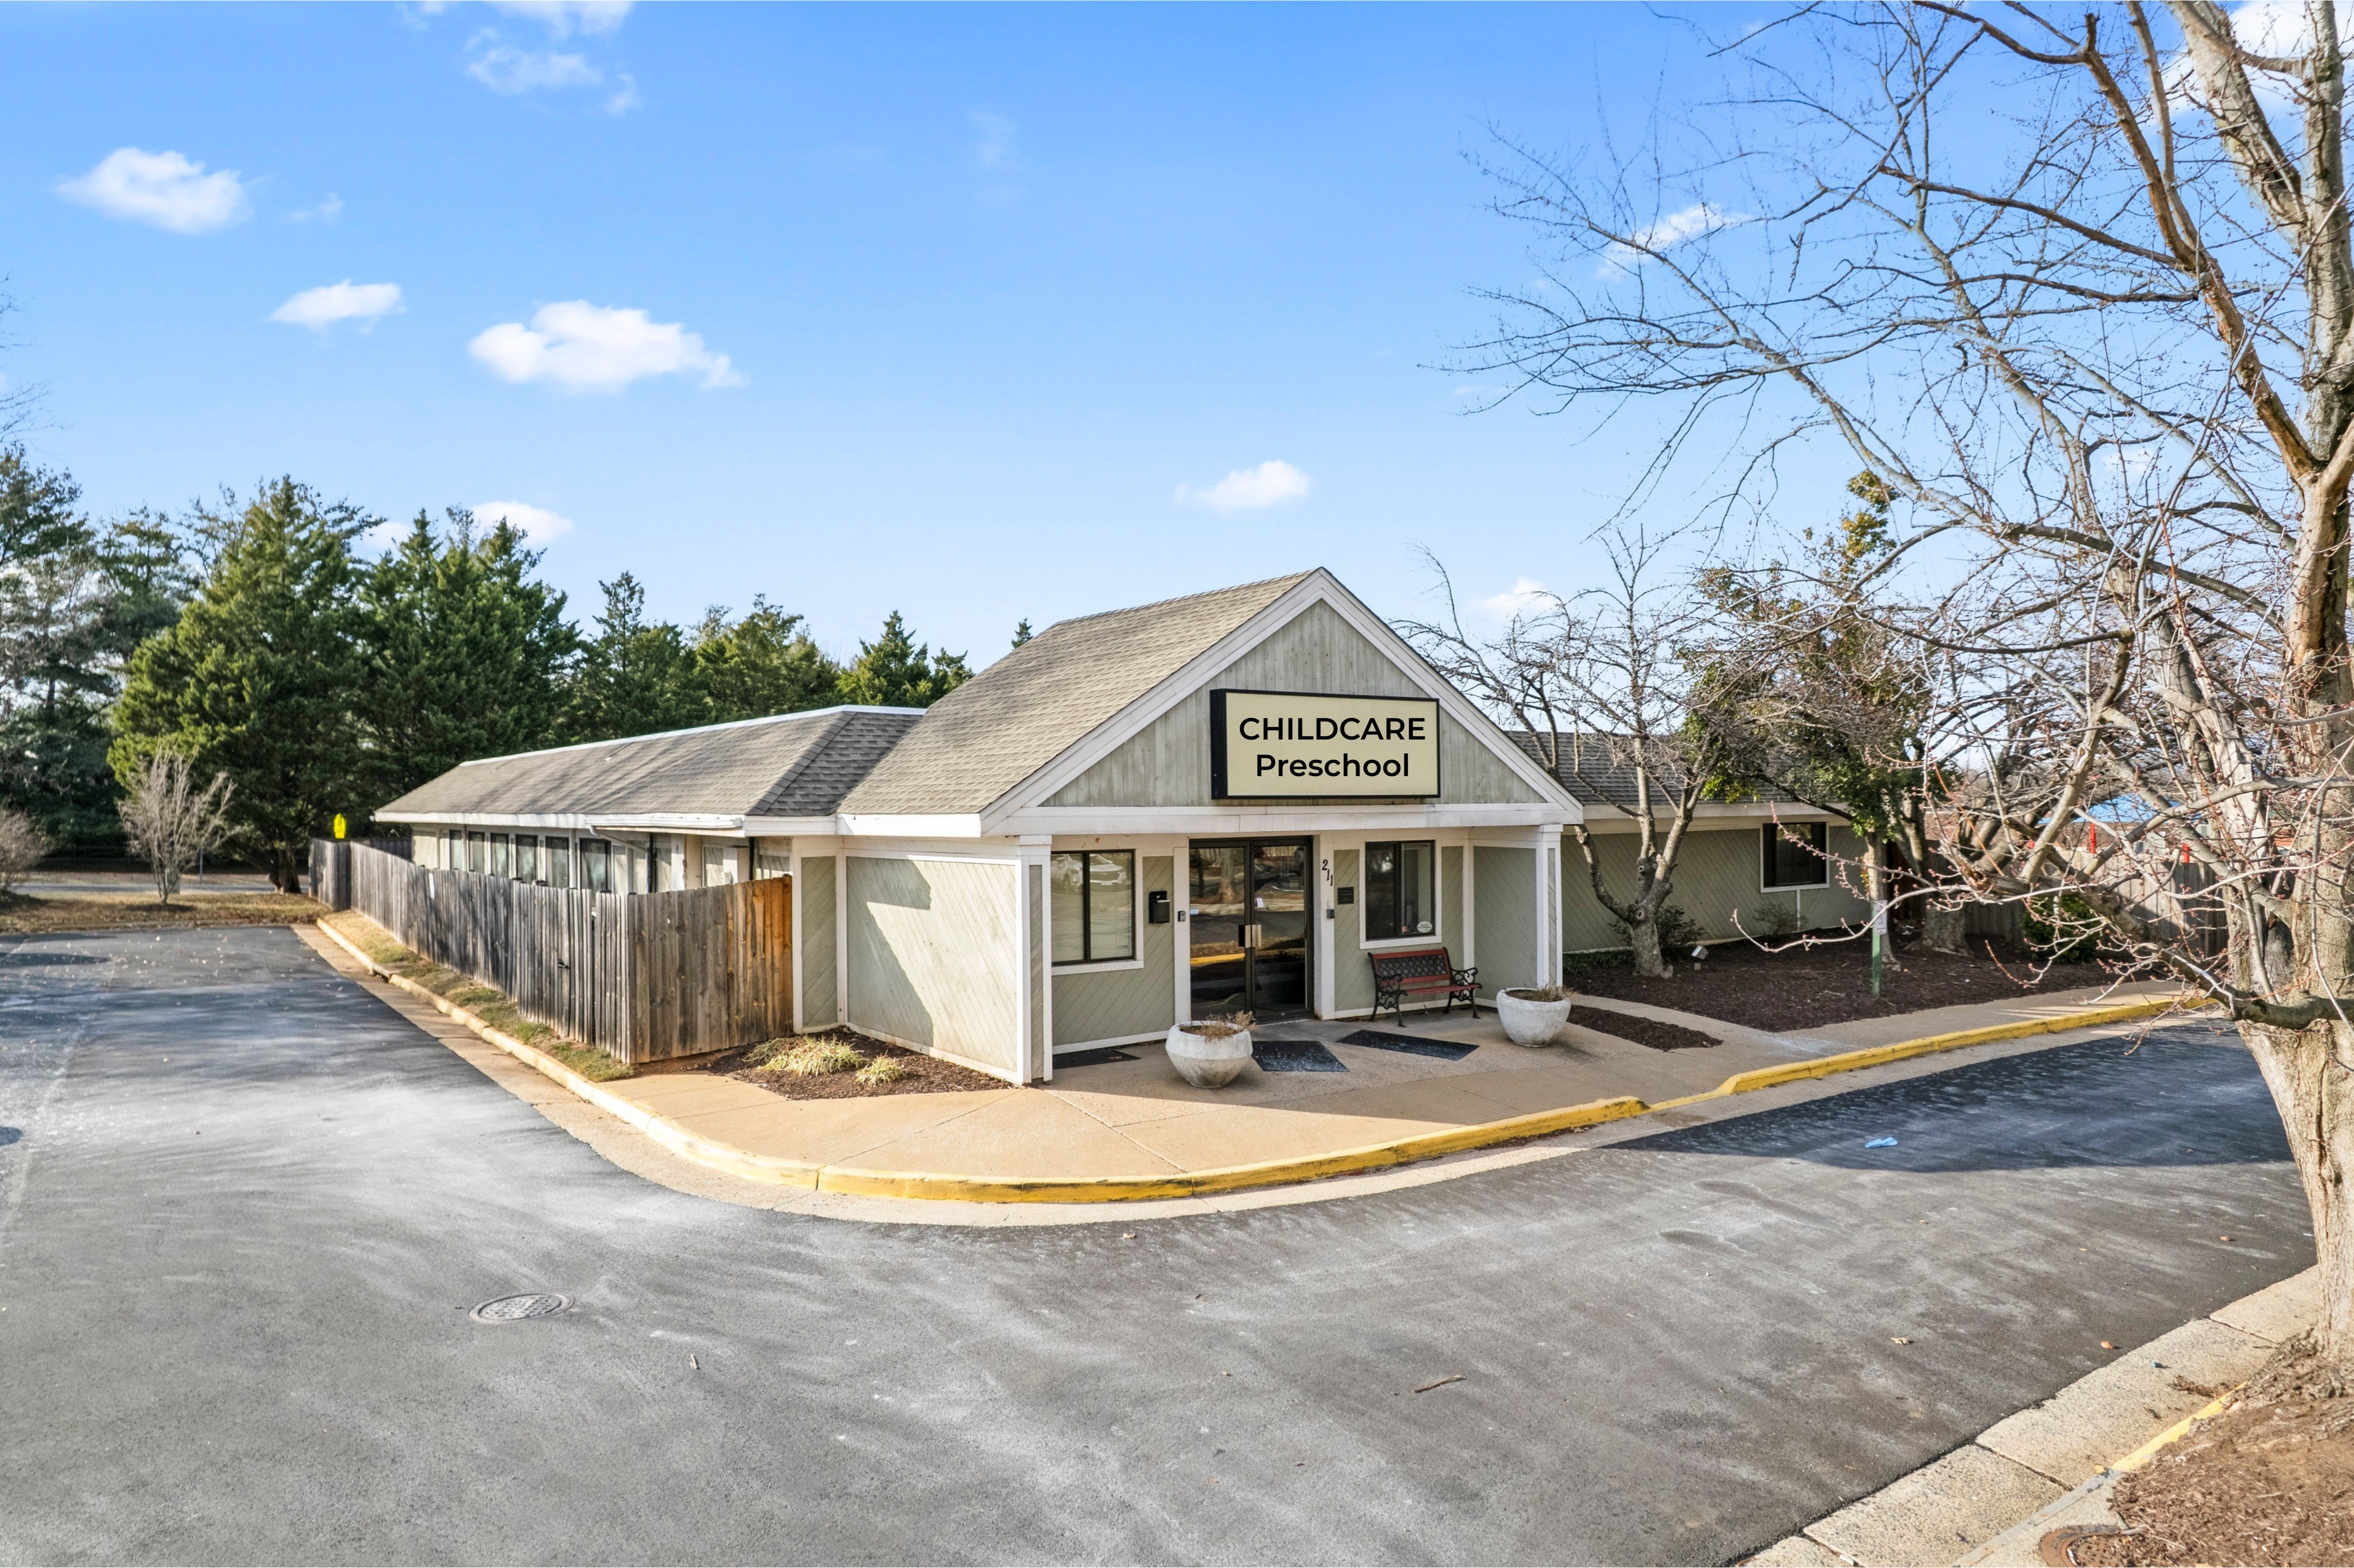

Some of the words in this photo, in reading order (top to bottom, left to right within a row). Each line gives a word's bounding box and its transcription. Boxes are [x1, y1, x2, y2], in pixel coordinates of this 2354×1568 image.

[1240, 717, 1425, 740] CHILDCARE
[1257, 753, 1408, 777] Preschool
[1322, 859, 1333, 886] 211
